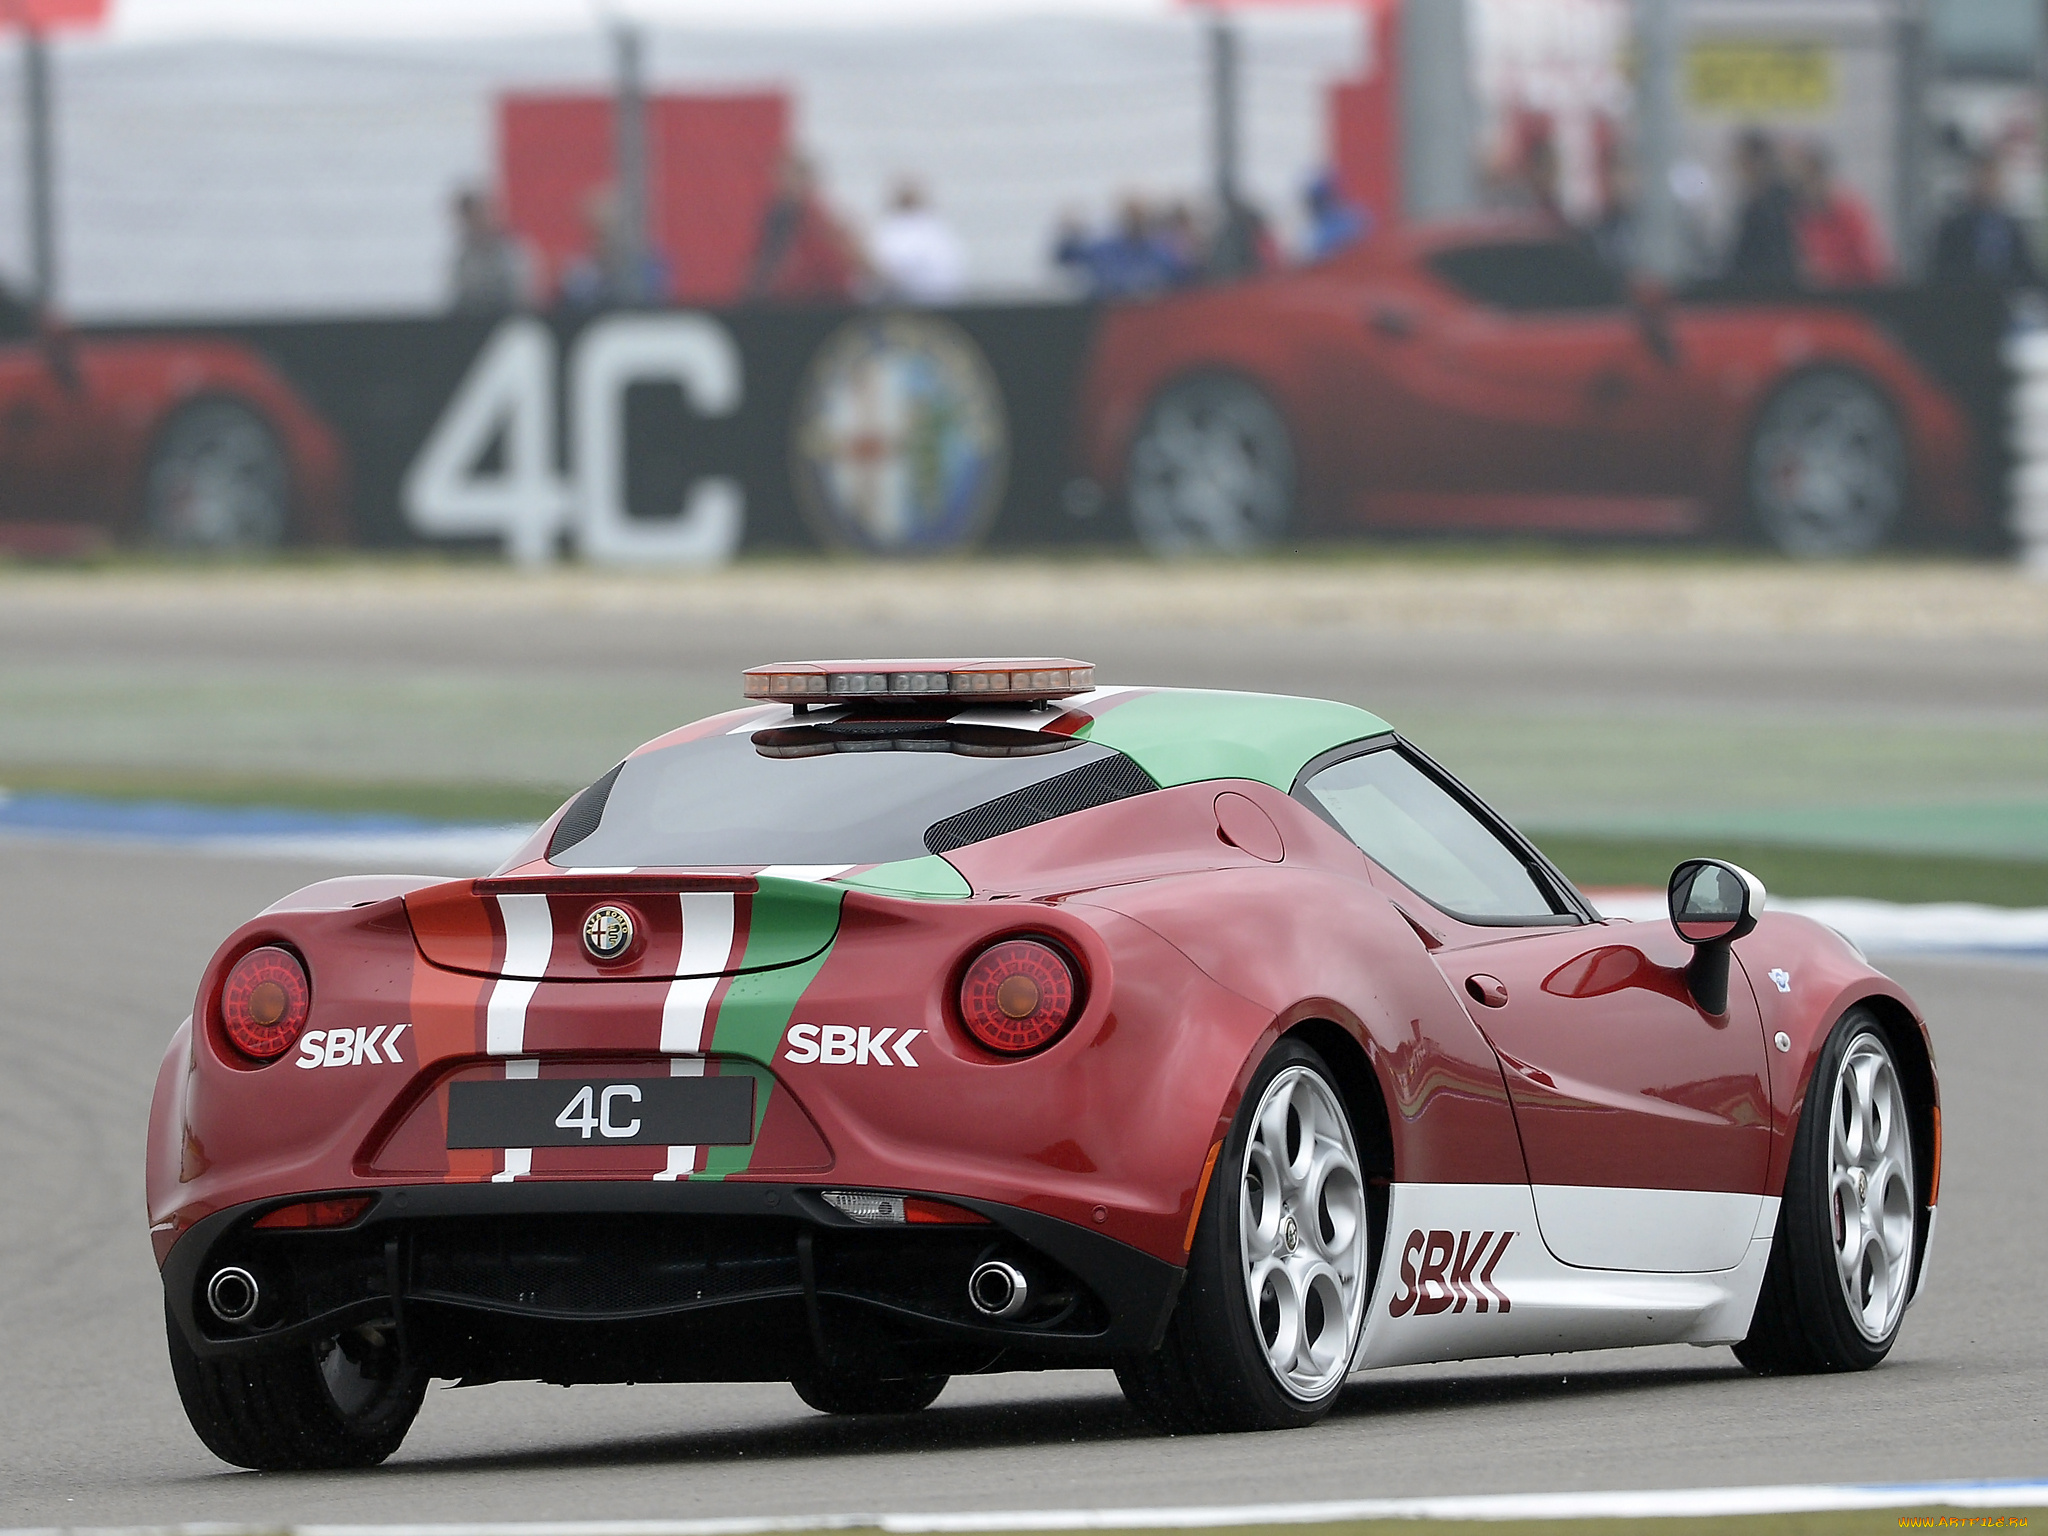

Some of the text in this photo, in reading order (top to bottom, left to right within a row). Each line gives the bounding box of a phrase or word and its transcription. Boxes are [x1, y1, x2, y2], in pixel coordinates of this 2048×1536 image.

[402, 314, 745, 566] 4C
[605, 910, 629, 934] ROMEO
[295, 1024, 406, 1069] SBK
[784, 1023, 922, 1067] SBK
[555, 1084, 642, 1138] 4C
[1388, 1228, 1515, 1318] SBK
